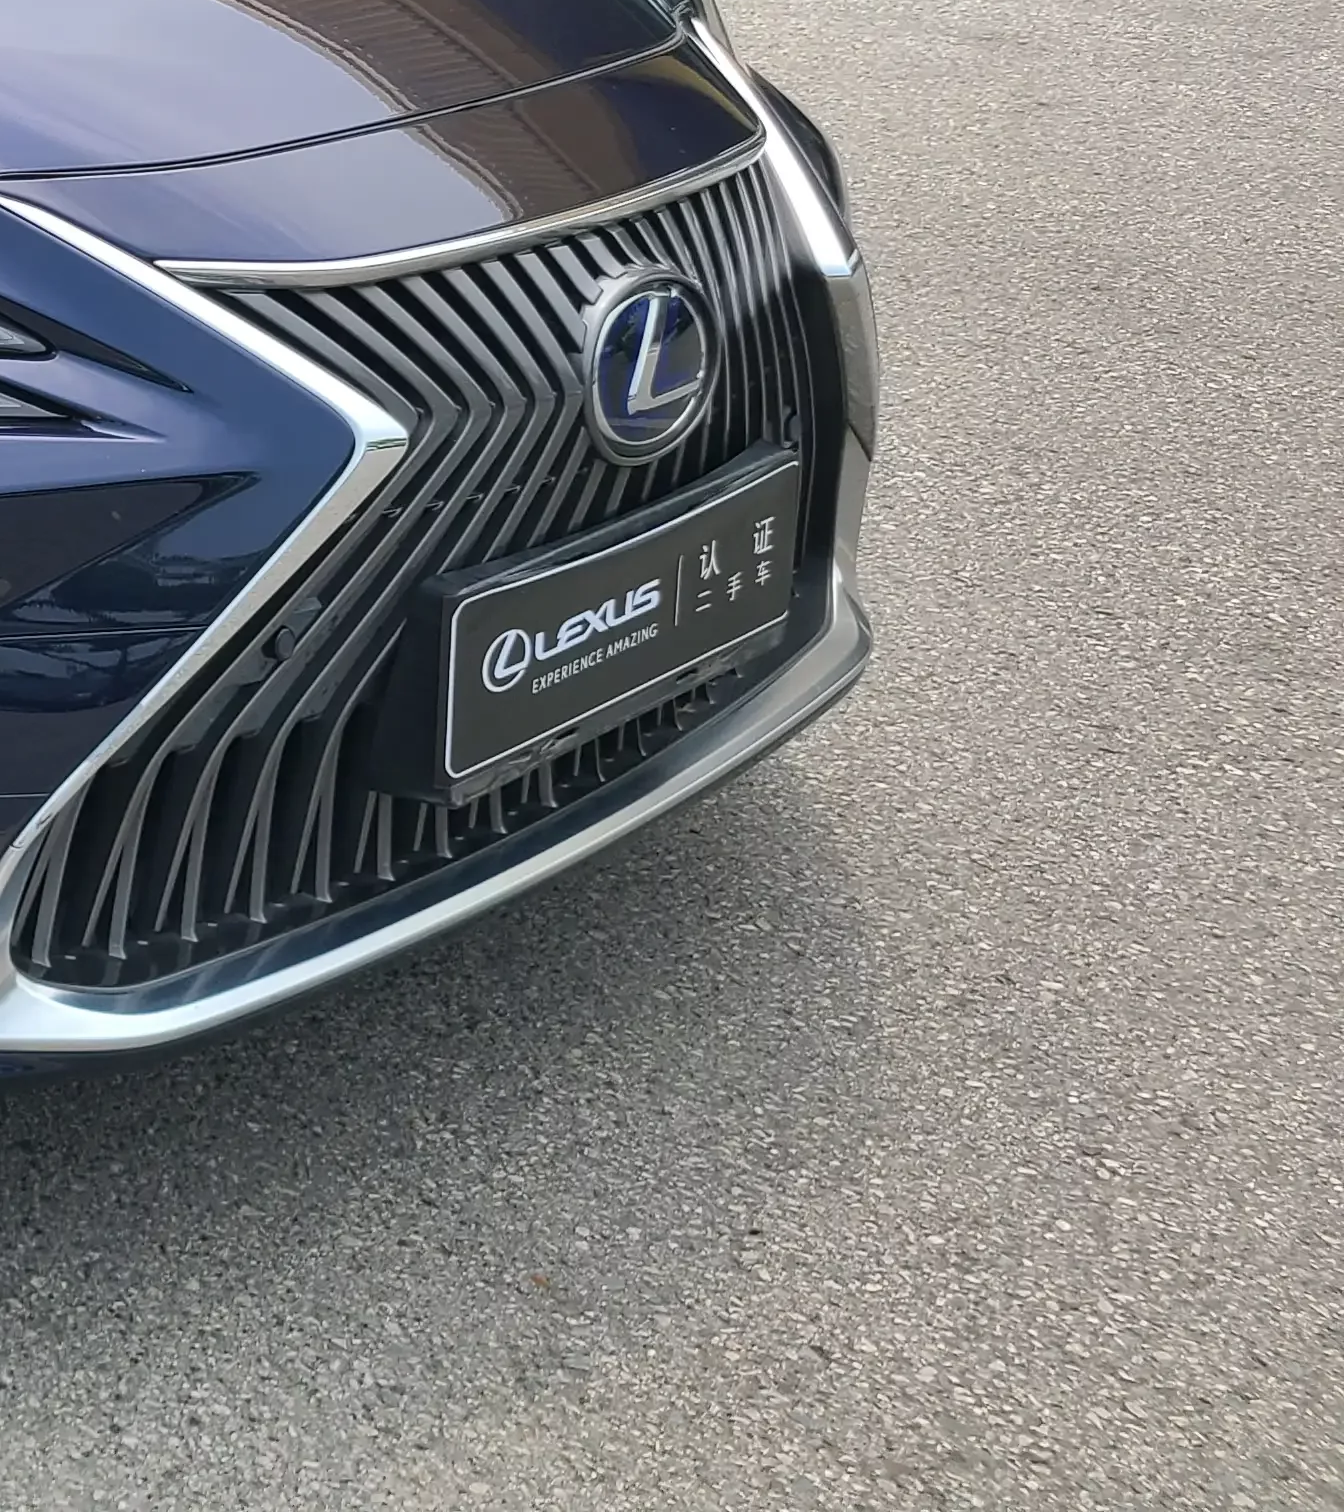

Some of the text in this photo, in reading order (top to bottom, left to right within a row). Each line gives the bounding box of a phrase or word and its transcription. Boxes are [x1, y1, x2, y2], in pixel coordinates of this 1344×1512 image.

[698, 516, 776, 580] 认证
[534, 577, 661, 661] LEXUS
[695, 560, 773, 612] 二手车
[531, 622, 659, 694] EXPERIENCE AMAZING
